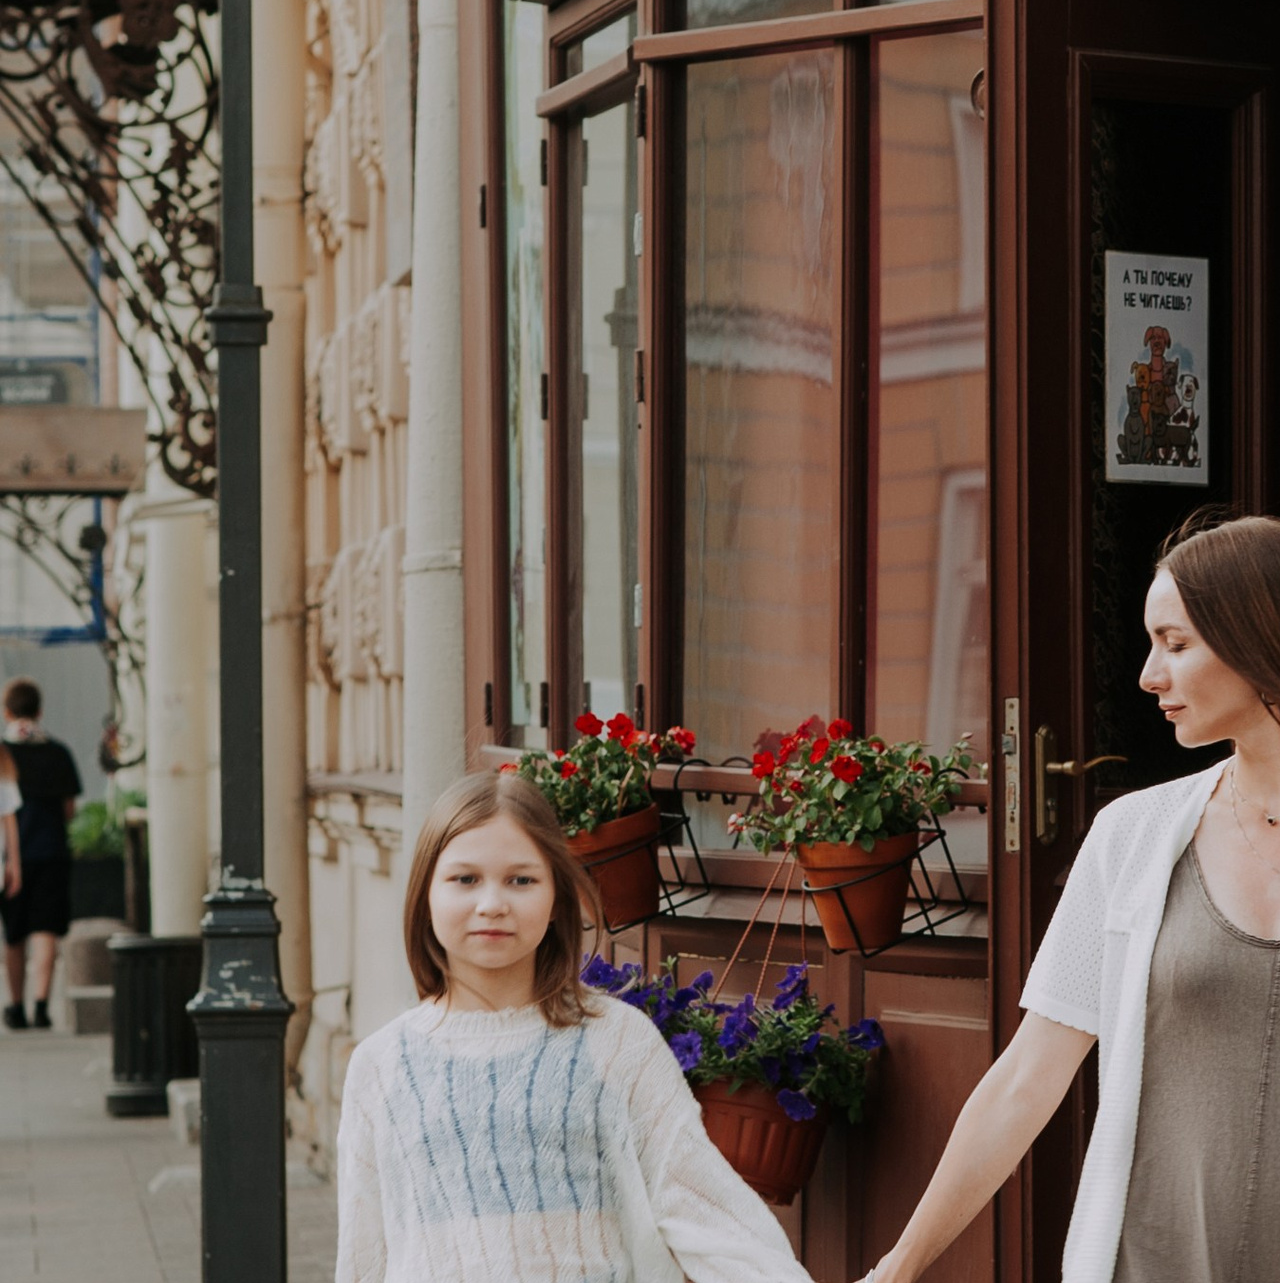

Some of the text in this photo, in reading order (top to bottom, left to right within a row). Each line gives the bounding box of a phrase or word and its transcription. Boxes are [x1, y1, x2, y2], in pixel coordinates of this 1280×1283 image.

[1123, 269, 1193, 288] А ТЫ ПОЧЕМУ
[1124, 292, 1193, 312] НЕ ЧИТАЕШЬ?
